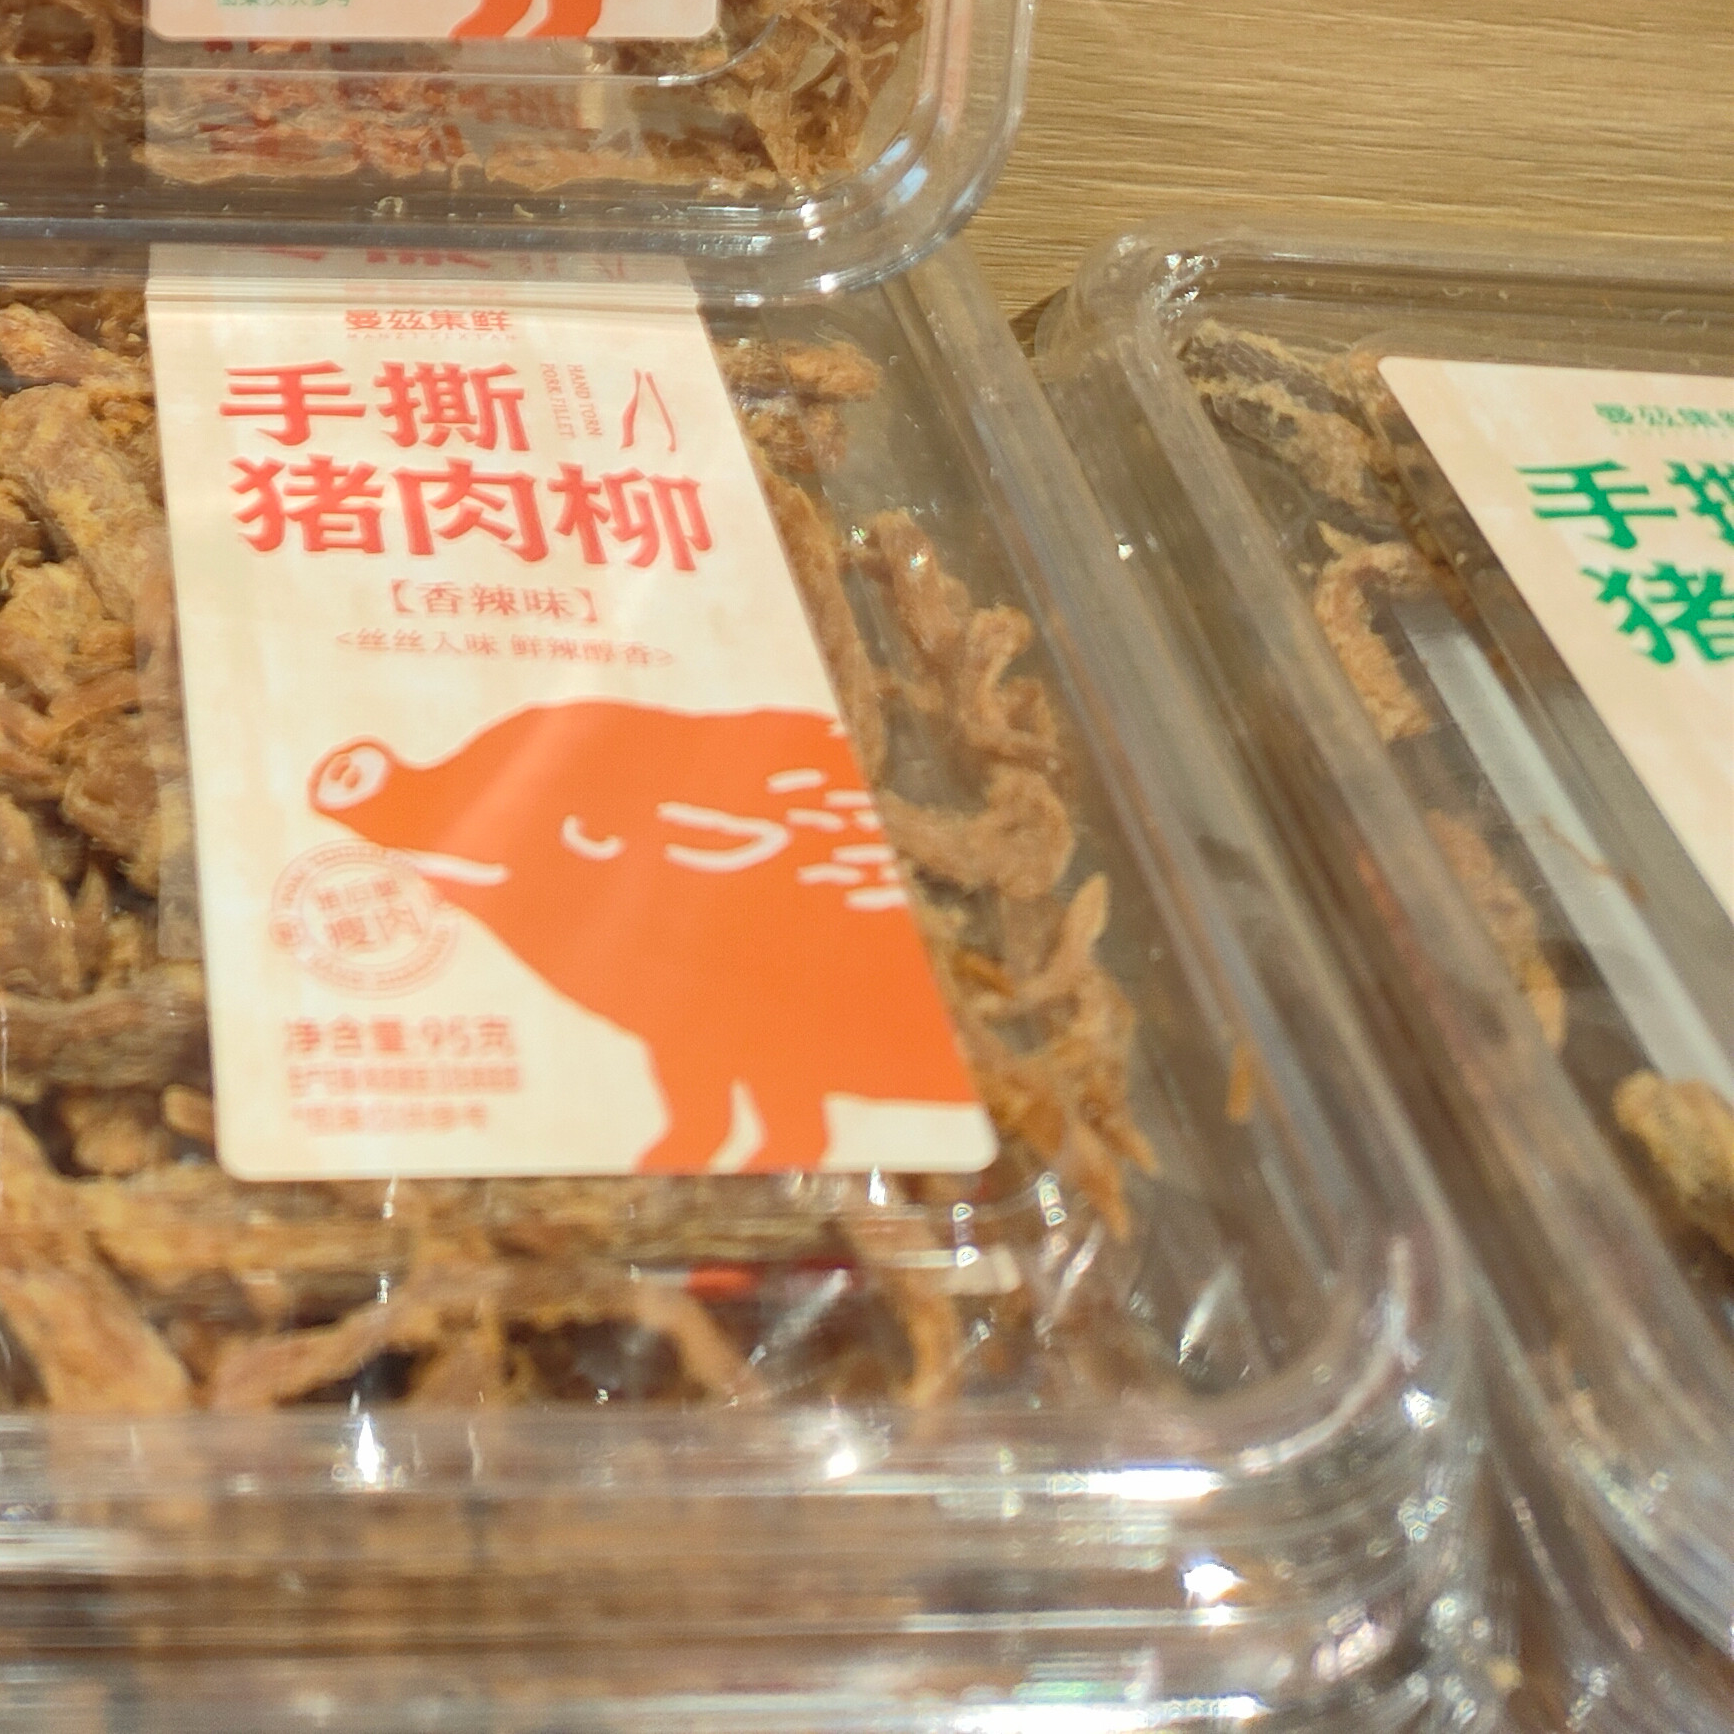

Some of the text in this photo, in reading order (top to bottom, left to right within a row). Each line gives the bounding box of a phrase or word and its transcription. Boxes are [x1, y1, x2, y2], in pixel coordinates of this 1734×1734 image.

[219, 360, 531, 452] 手撕
[540, 363, 577, 439] PORK FILLET
[566, 364, 603, 436] HAND TORN
[229, 454, 713, 572] 猪肉柳
[390, 578, 598, 623] 【香辣味】
